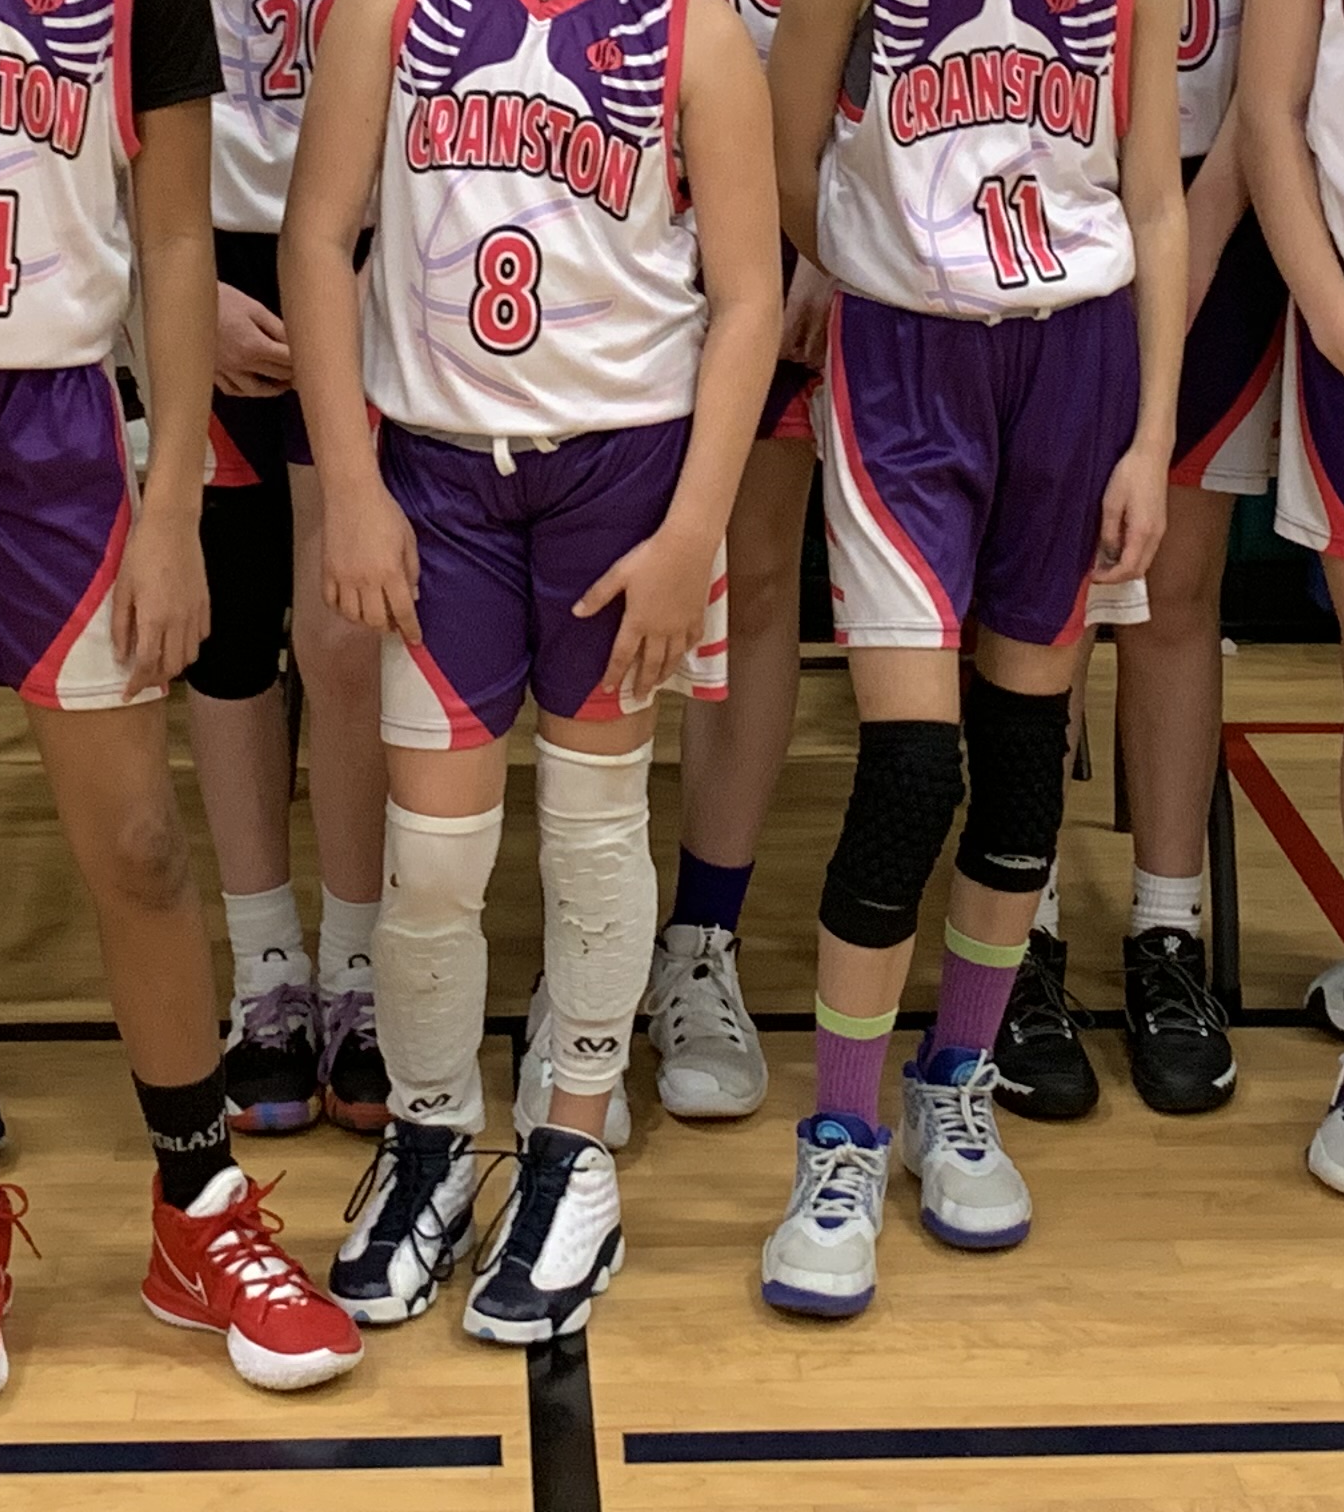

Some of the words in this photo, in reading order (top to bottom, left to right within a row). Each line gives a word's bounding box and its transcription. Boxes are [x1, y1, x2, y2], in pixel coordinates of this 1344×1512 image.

[406, 89, 643, 220] CRANSTON
[889, 44, 1104, 148] CRANSTON
[469, 224, 542, 357] 8
[974, 175, 1066, 288] 11
